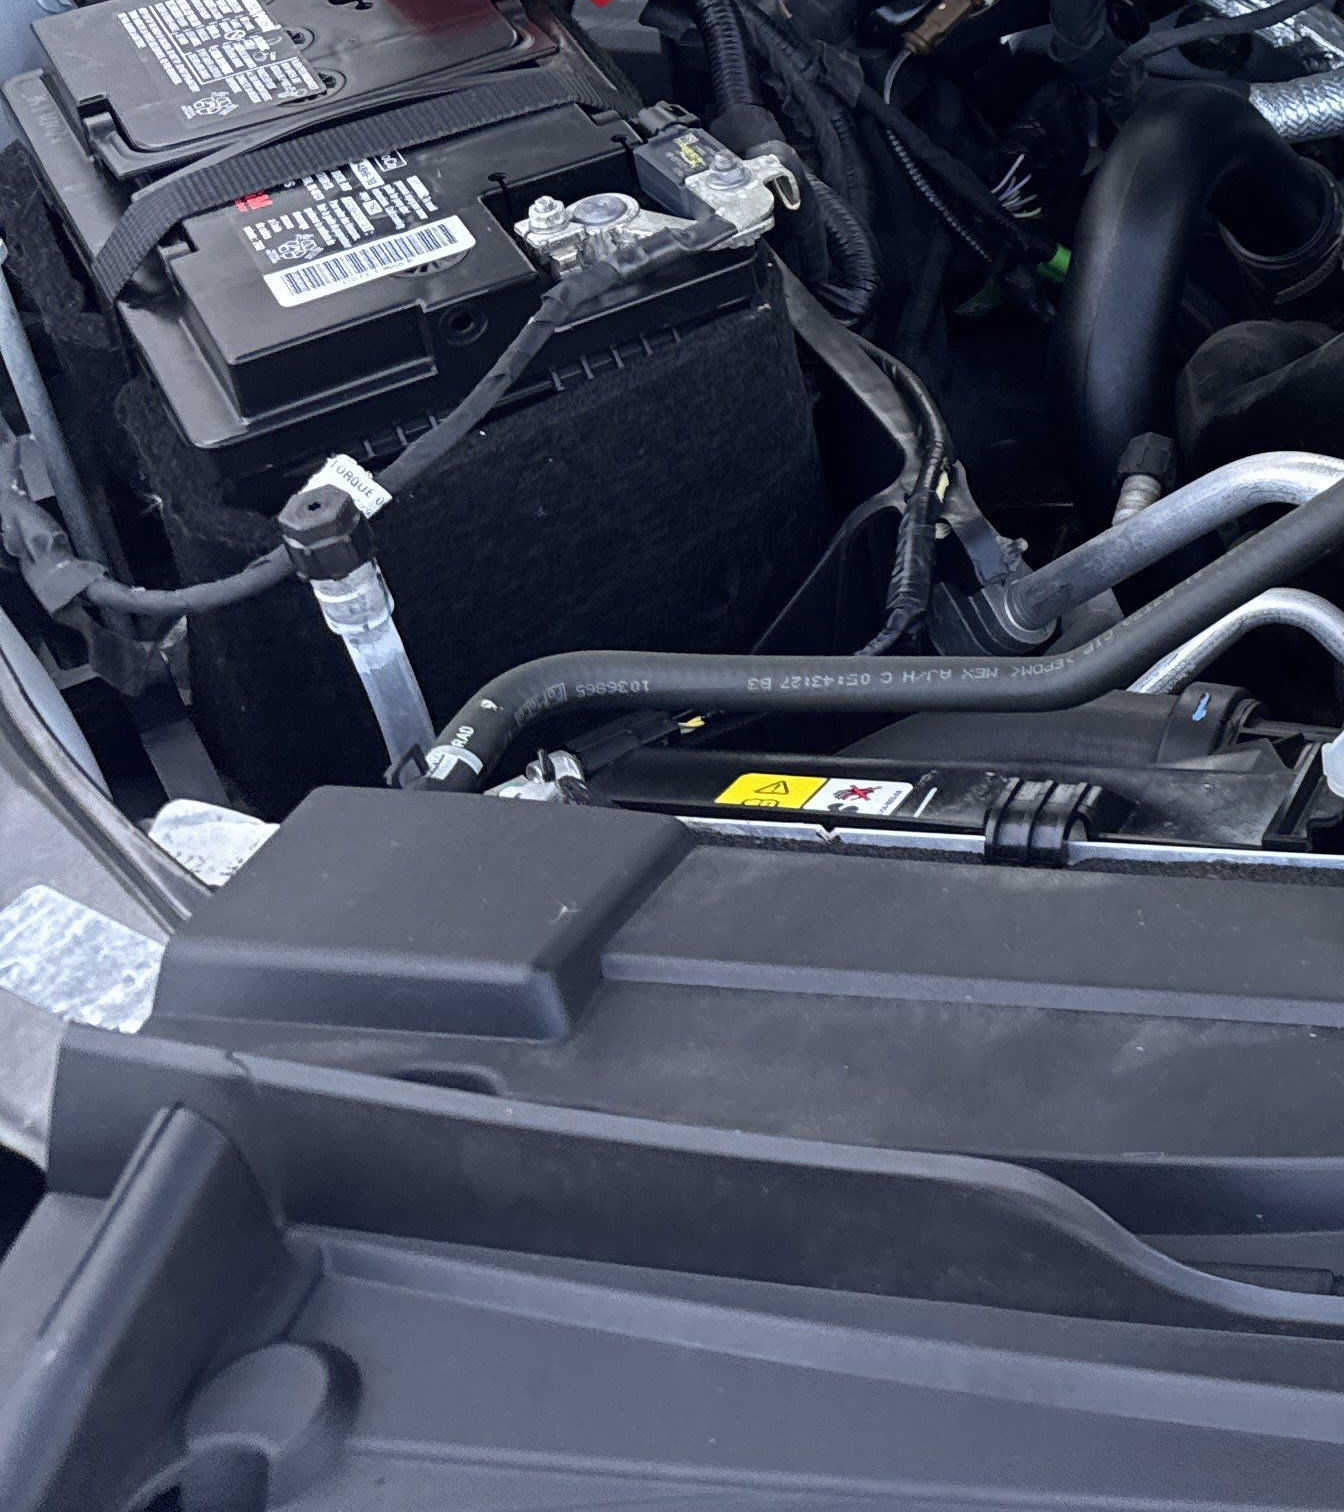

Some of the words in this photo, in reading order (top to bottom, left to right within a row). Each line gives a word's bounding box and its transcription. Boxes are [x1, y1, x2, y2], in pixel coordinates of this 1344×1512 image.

[331, 460, 374, 498] TORQUE
[880, 671, 893, 684] C
[960, 667, 999, 680] MEX
[747, 677, 771, 691] B3
[778, 673, 871, 690] 05:43:27
[451, 725, 475, 748] RAD
